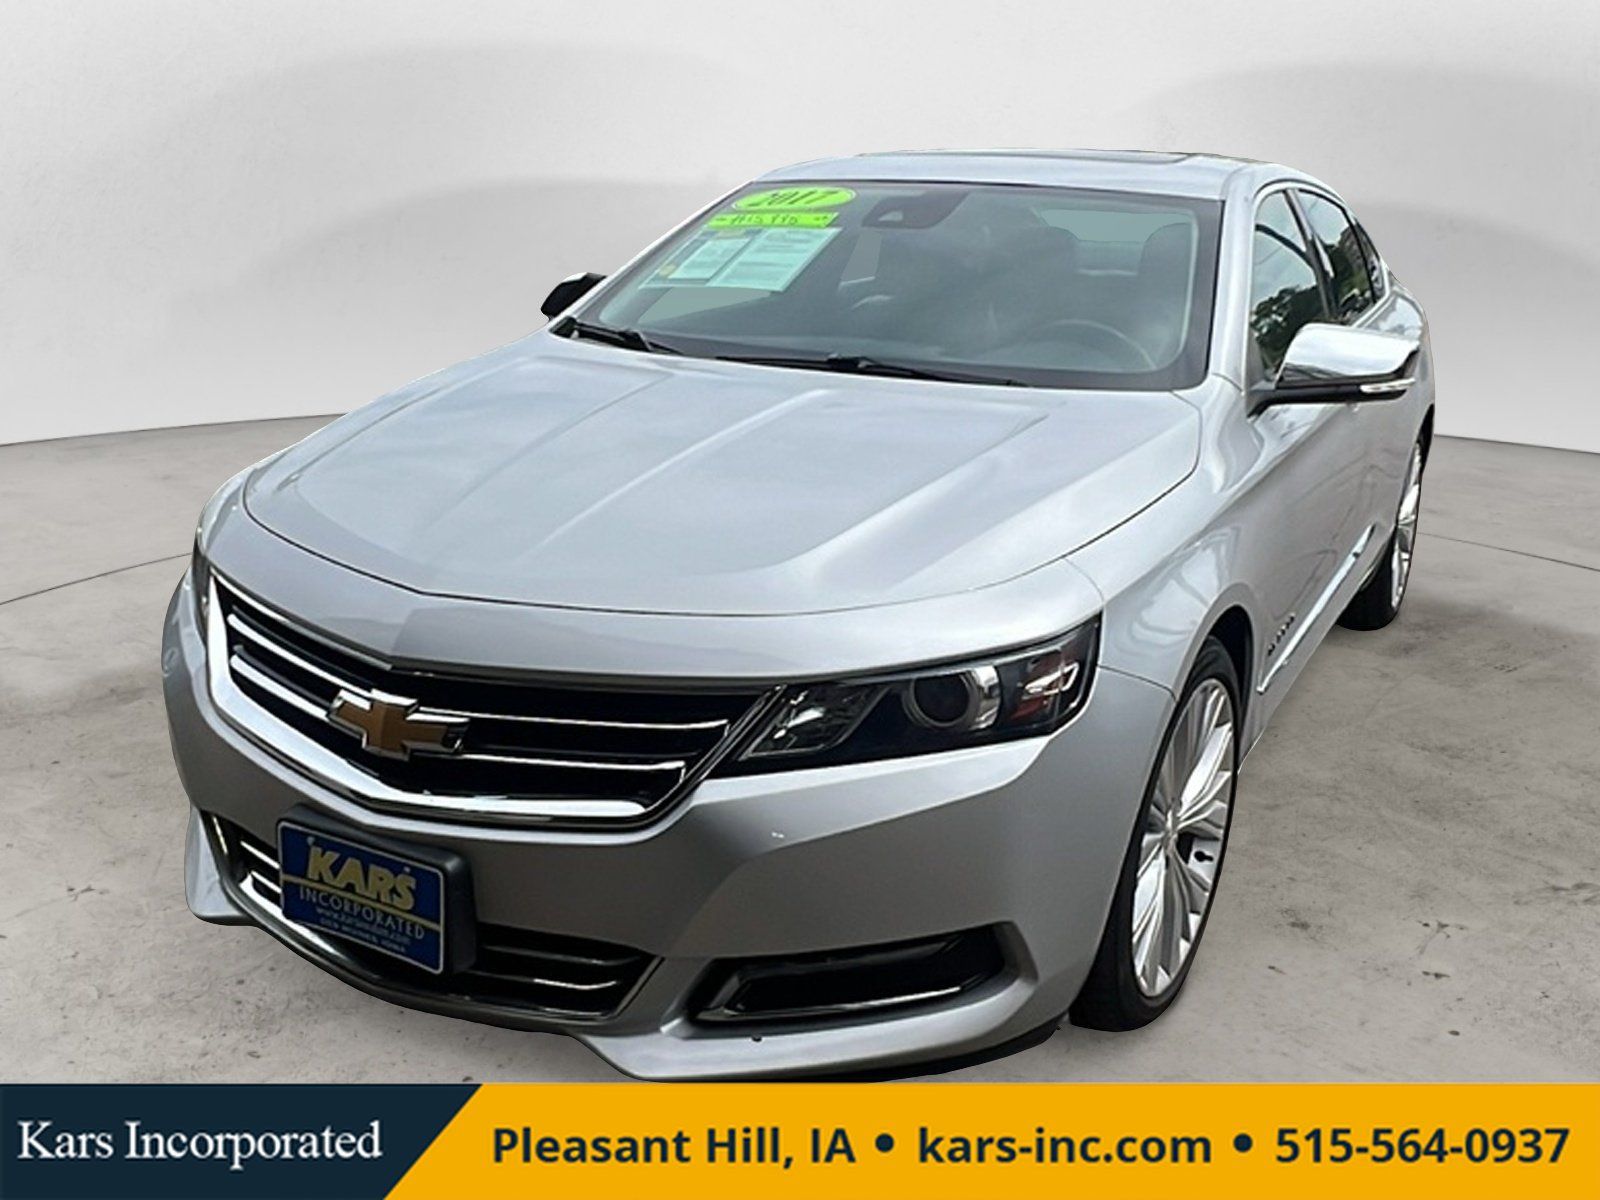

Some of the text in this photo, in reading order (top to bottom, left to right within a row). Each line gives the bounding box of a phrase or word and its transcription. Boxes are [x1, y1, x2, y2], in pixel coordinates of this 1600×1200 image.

[747, 189, 842, 207] 2017
[306, 845, 417, 911] KARS
[299, 887, 426, 940] INCORPORATED
